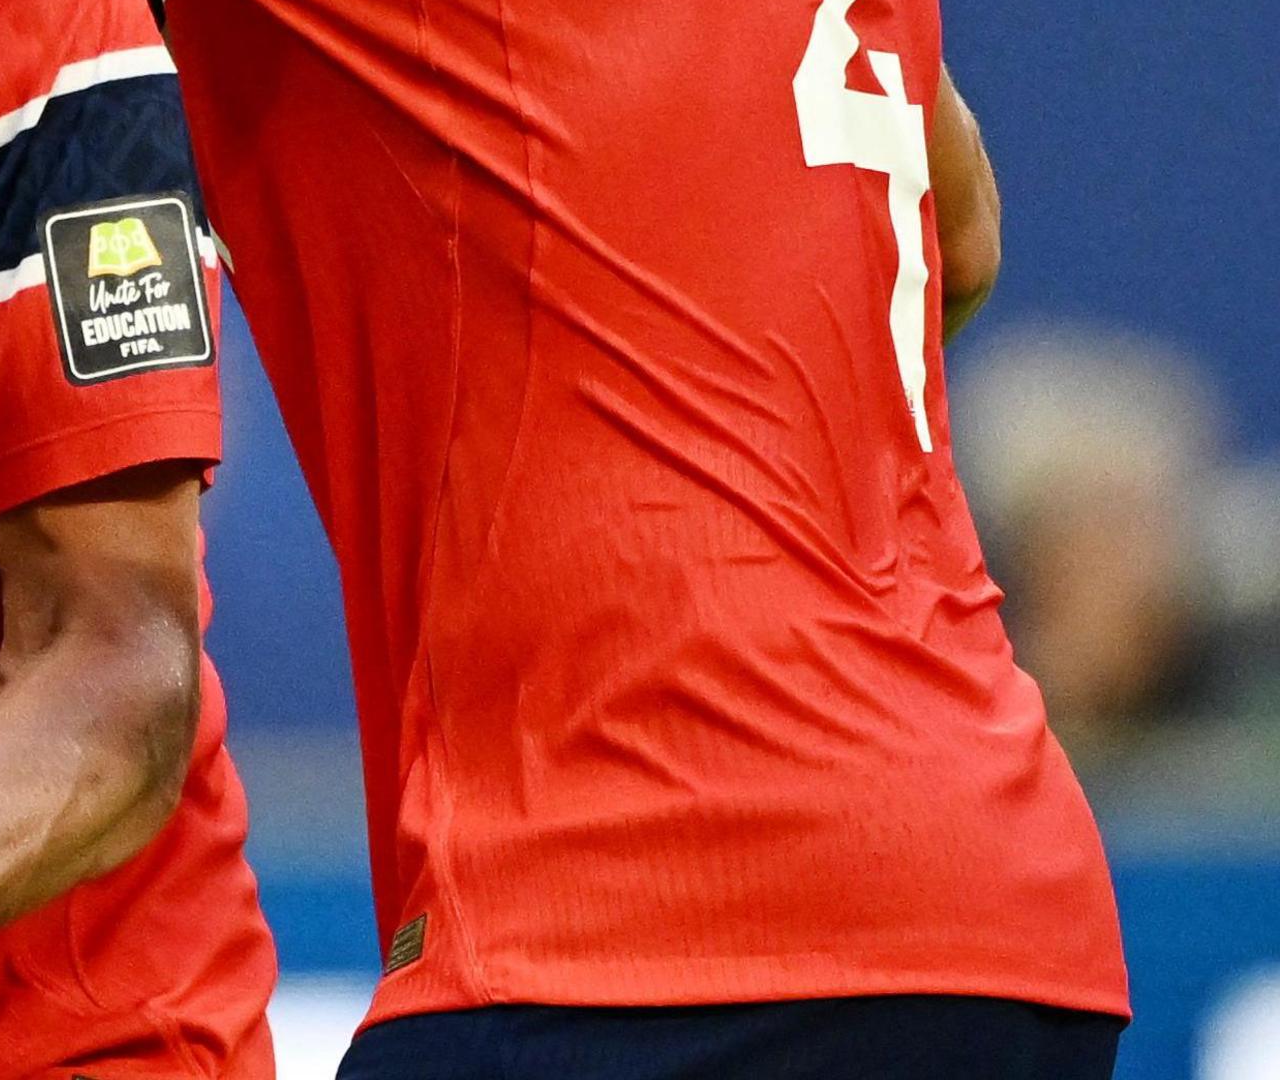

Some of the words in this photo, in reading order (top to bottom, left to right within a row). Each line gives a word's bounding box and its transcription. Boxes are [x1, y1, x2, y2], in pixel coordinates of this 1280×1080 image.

[89, 279, 141, 314] Unite
[139, 272, 171, 304] For
[81, 303, 191, 346] EDUCATION
[120, 338, 164, 358] FIFA
